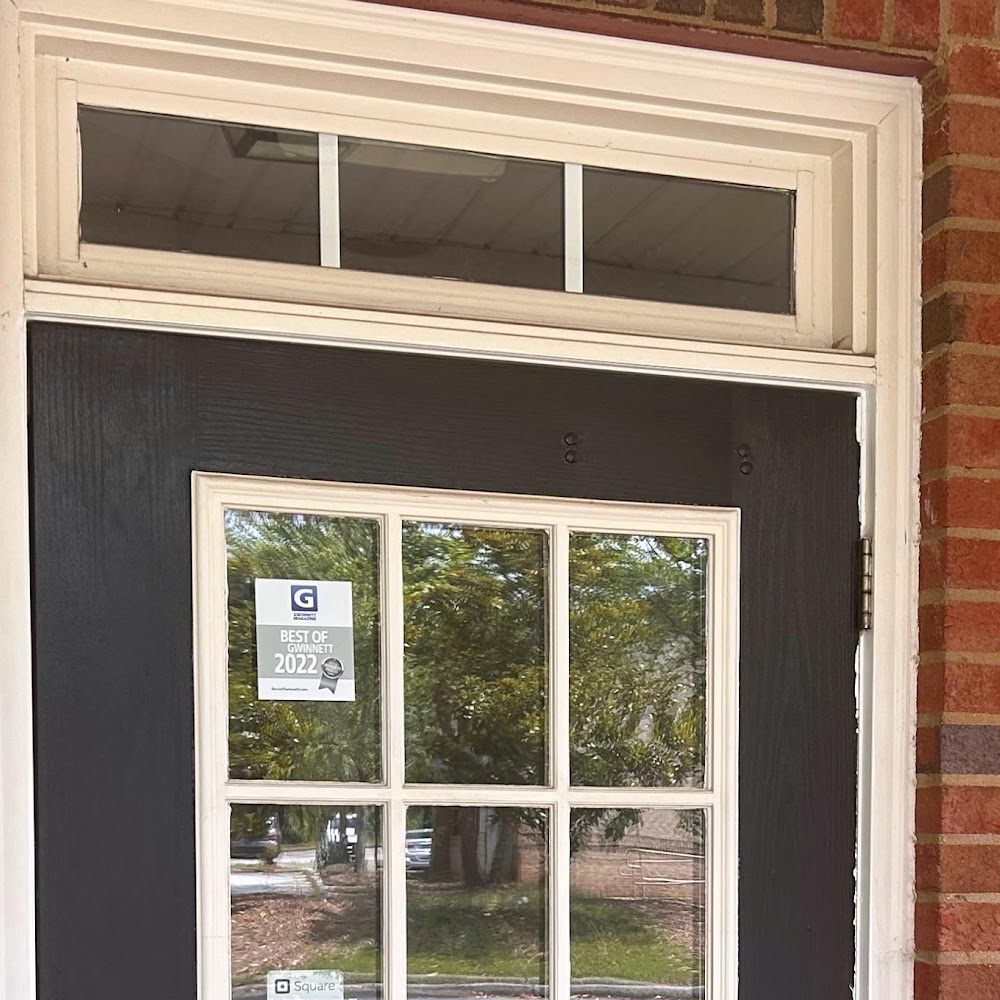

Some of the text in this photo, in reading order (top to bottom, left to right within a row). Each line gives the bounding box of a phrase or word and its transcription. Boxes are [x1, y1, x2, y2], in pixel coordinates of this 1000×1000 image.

[294, 588, 314, 608] G
[280, 630, 328, 643] BEST OF
[287, 643, 334, 653] GWINNETT
[274, 653, 318, 674] 2022
[294, 981, 335, 993] Square
